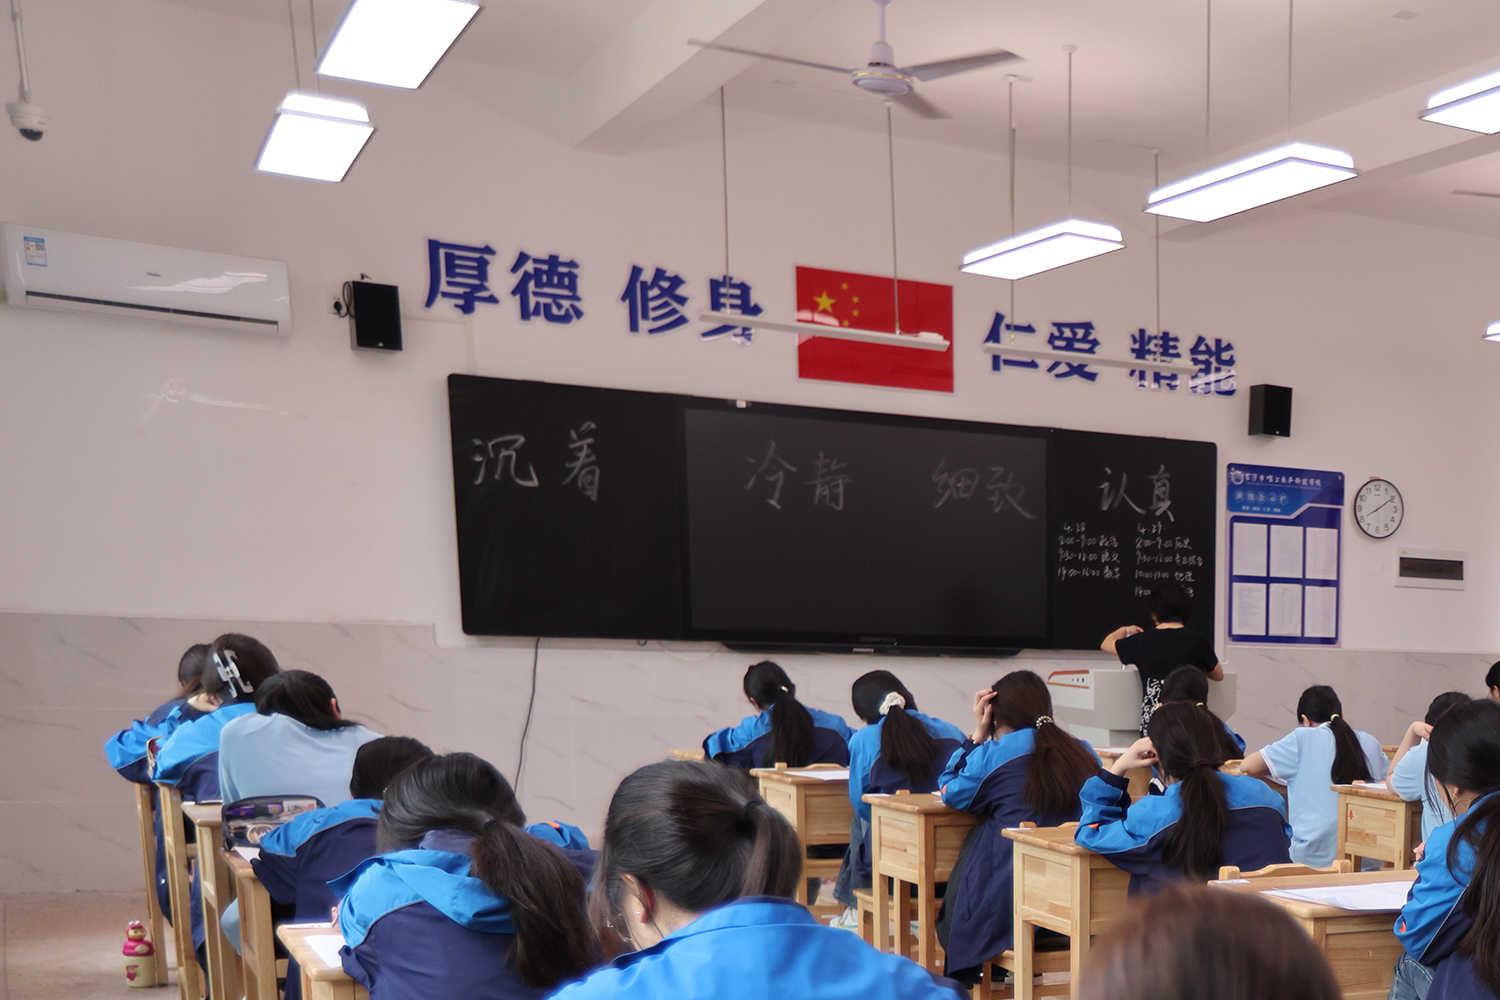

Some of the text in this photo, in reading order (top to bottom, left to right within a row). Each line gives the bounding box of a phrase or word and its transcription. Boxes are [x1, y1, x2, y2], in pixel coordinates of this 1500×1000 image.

[424, 238, 764, 342] 厚德 修身
[983, 311, 1101, 383] 仁爱
[471, 421, 1176, 523] 沉着 冷静 细致 认真
